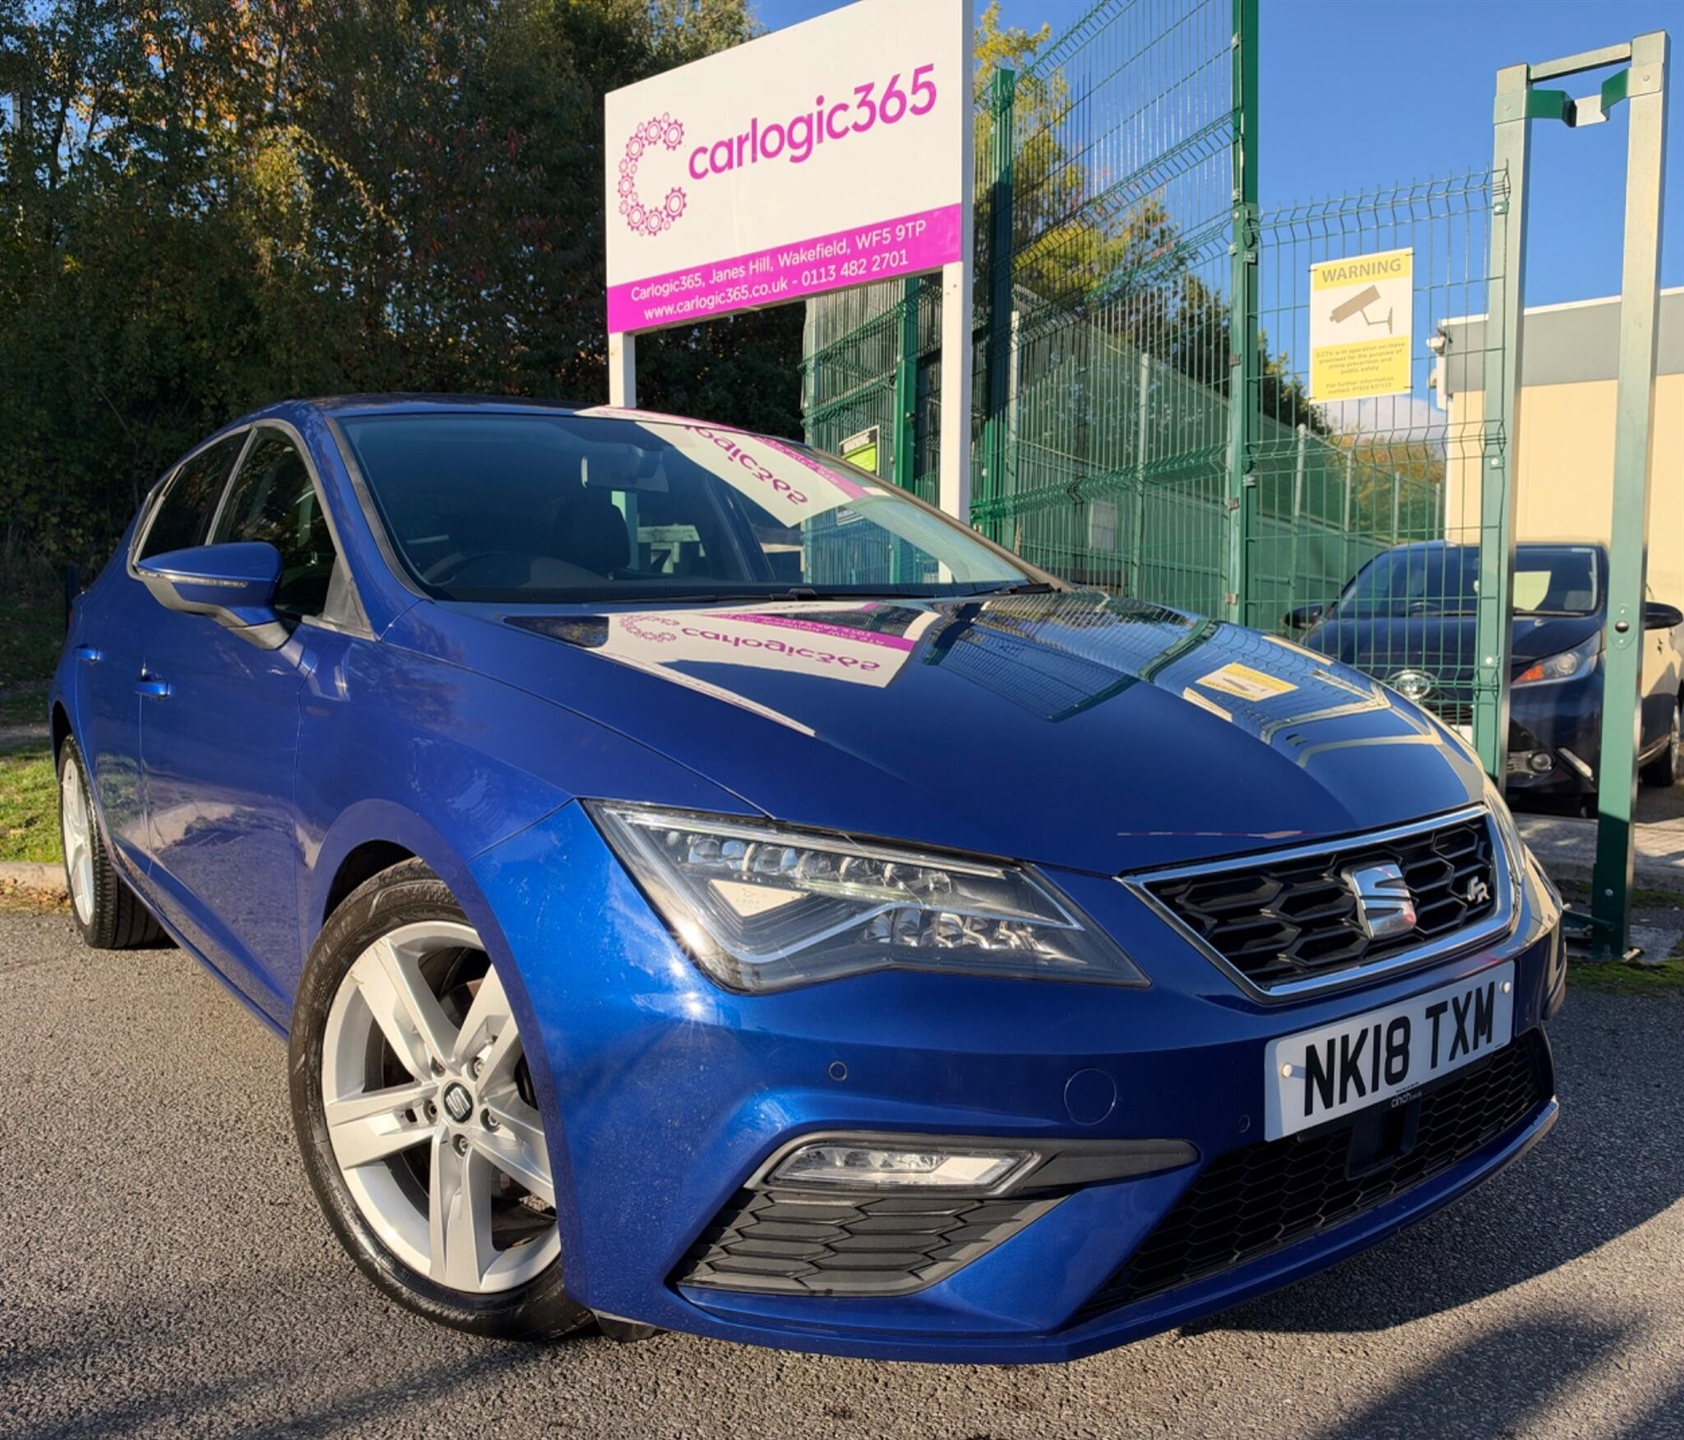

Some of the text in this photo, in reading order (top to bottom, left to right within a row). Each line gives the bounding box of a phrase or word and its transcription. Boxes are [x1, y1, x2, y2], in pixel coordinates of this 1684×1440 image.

[688, 63, 937, 180] carlogic365
[631, 219, 927, 301] Carlogic365, Janes Hill, Wakefield, WF5 9TP
[643, 276, 788, 320] www.carlogic365.co.uk
[801, 264, 837, 287] 0113
[840, 258, 867, 277] 482
[871, 249, 909, 272] 2701
[1322, 258, 1401, 283] WARNING
[1349, 345, 1377, 354] operation
[1361, 365, 1379, 373] safety
[1303, 981, 1495, 1117] NK18 TXM
